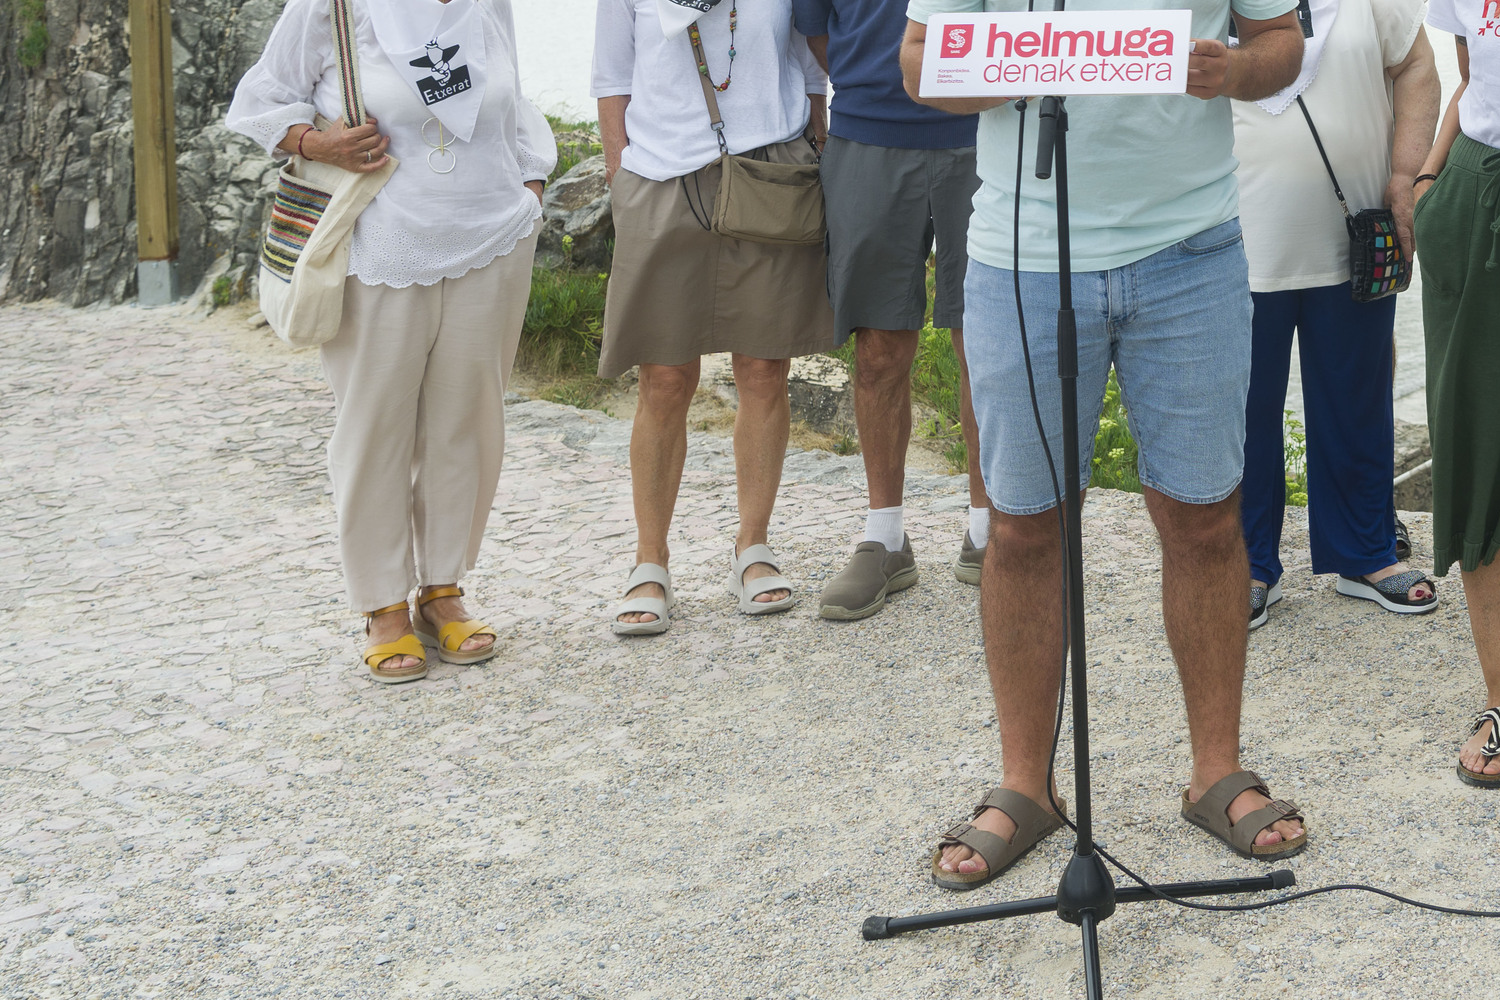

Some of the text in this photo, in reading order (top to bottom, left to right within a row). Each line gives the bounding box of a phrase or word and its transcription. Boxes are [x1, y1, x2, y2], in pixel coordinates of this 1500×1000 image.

[986, 22, 1175, 58] helmuga
[983, 58, 1172, 83] denak etxera
[423, 79, 471, 103] Etxerat
